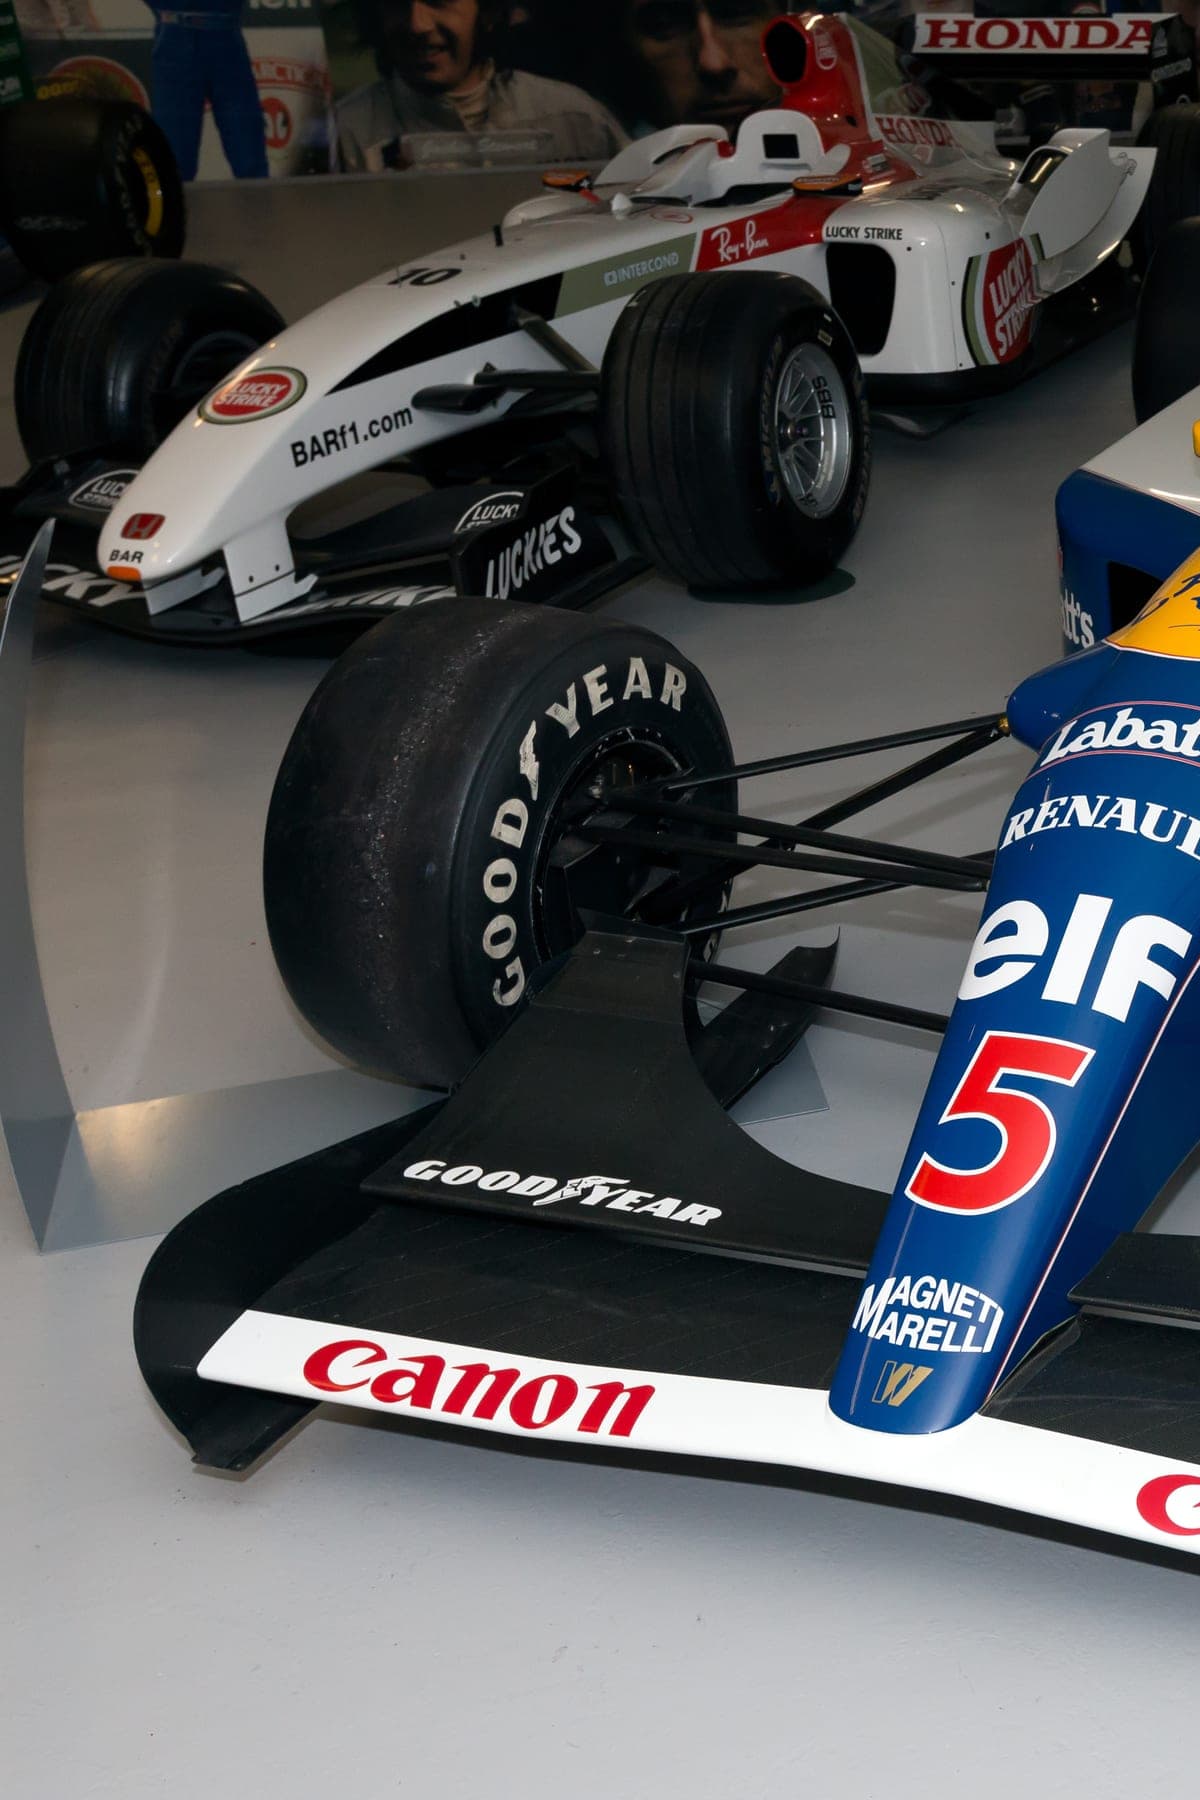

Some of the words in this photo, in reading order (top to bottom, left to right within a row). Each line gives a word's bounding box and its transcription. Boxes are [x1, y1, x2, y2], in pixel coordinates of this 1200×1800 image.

[925, 20, 1152, 49] HONDA
[710, 219, 769, 263] Ray-Ban
[826, 226, 860, 239] LUCKY
[864, 227, 903, 241] STRIKE
[387, 267, 463, 286] 10
[617, 252, 680, 283] INTERCOND
[988, 242, 1028, 319] LUCKY
[215, 393, 279, 408] STRIKE
[229, 381, 289, 394] LUCKY
[811, 375, 837, 420] BBS
[291, 407, 414, 467] BARf1.com
[109, 549, 144, 564] BAR
[485, 505, 583, 601] LUCKIES
[956, 893, 1194, 1023] elf
[904, 1030, 1097, 1216] 5
[302, 1338, 656, 1437] Canon
